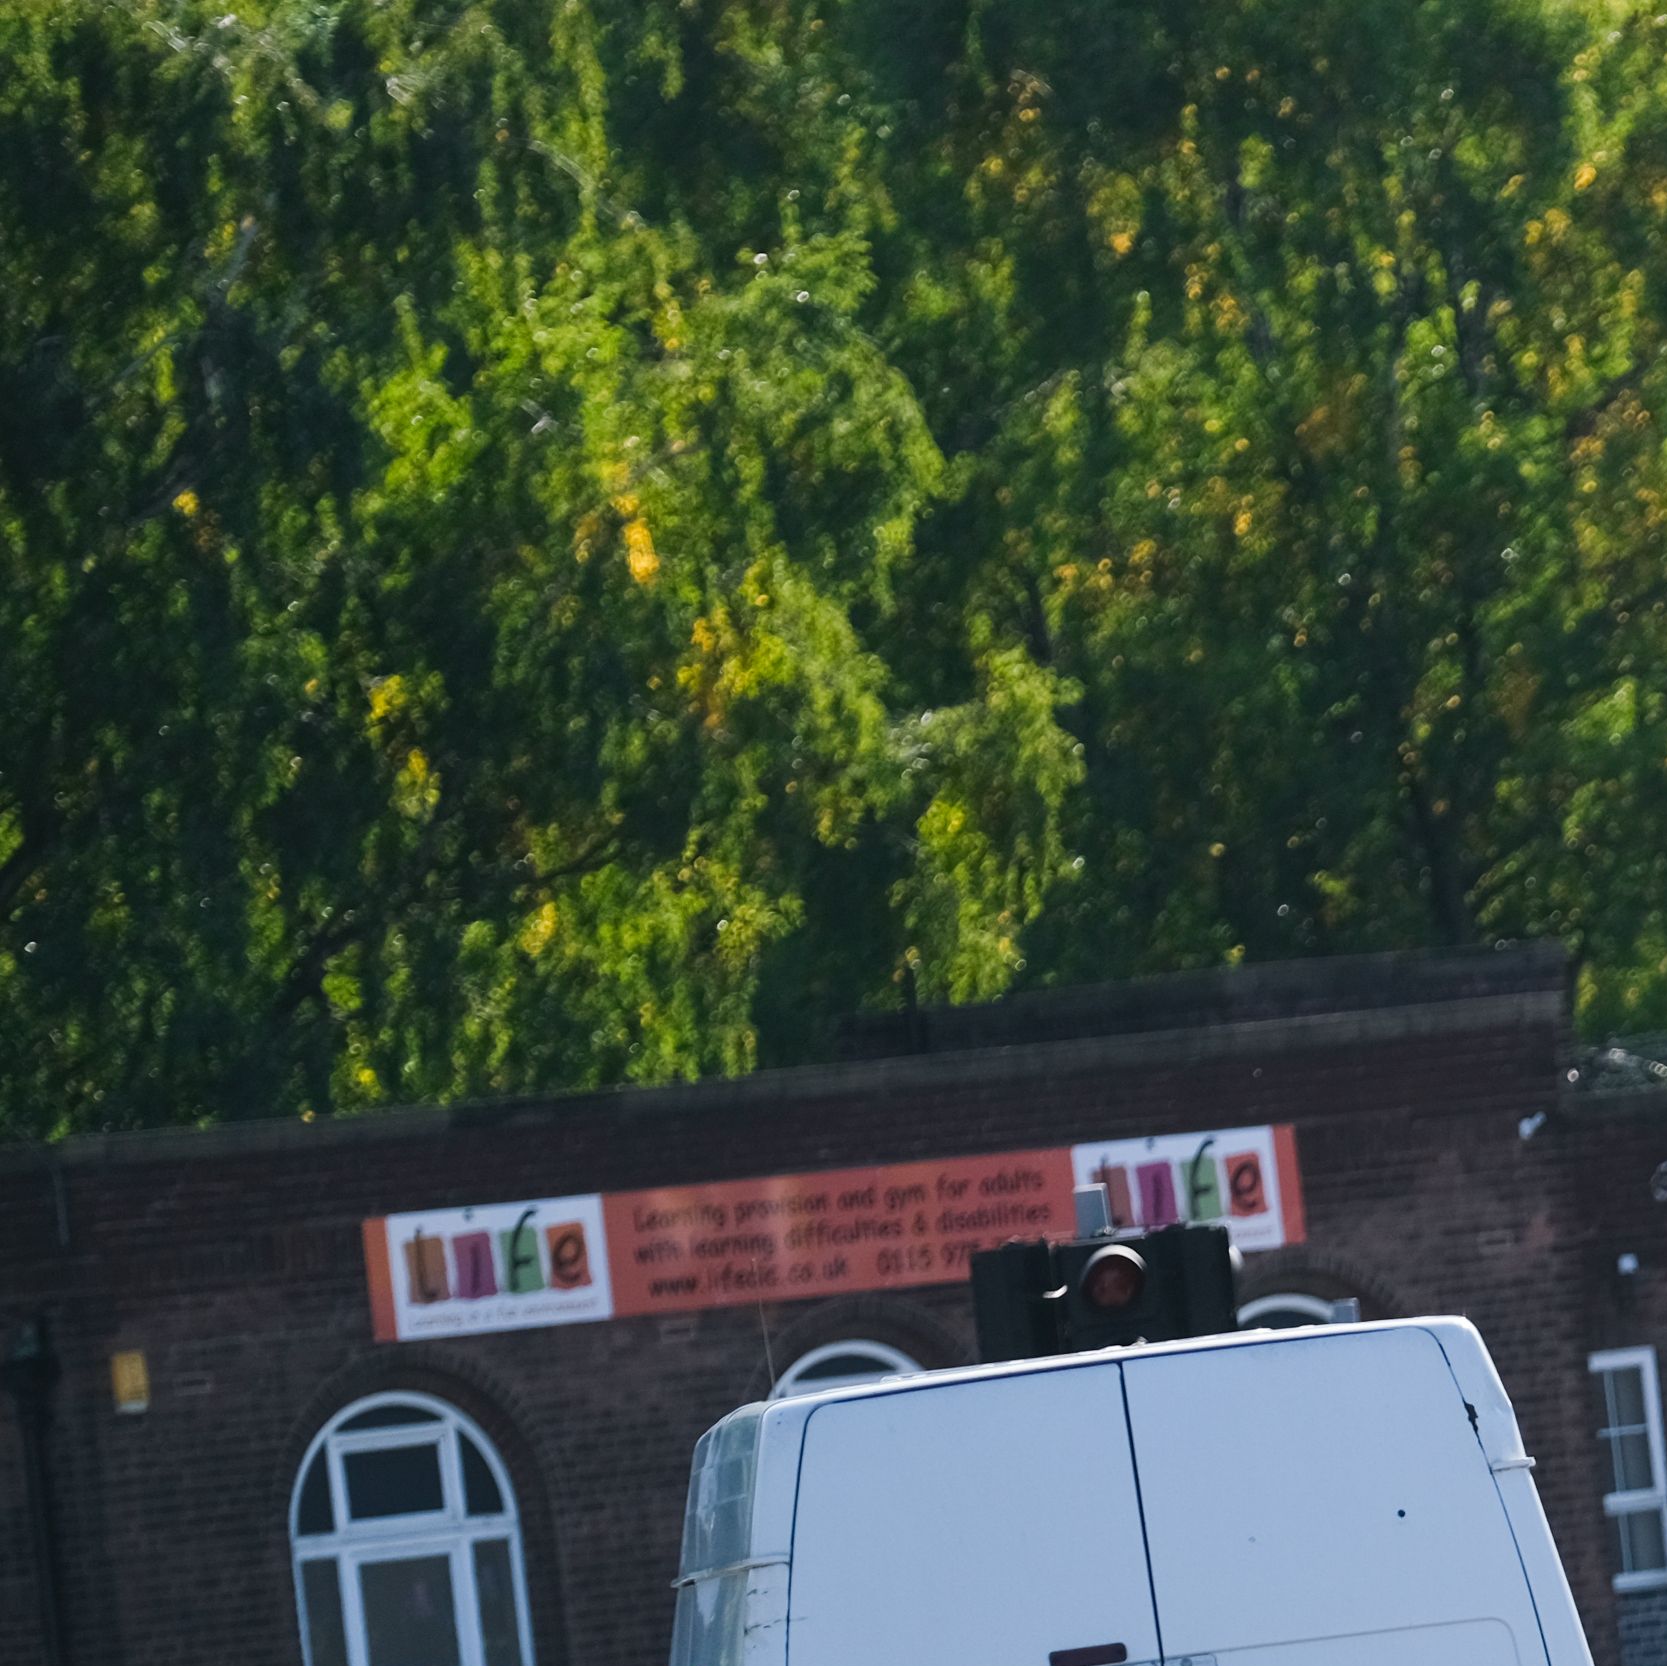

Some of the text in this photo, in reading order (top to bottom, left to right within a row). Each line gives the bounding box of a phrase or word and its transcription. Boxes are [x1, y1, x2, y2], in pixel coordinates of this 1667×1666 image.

[836, 1184, 877, 1211] and
[882, 1183, 926, 1212] gym
[935, 1171, 970, 1199] for
[978, 1167, 1044, 1196] adults
[935, 1202, 1051, 1235] disabilities
